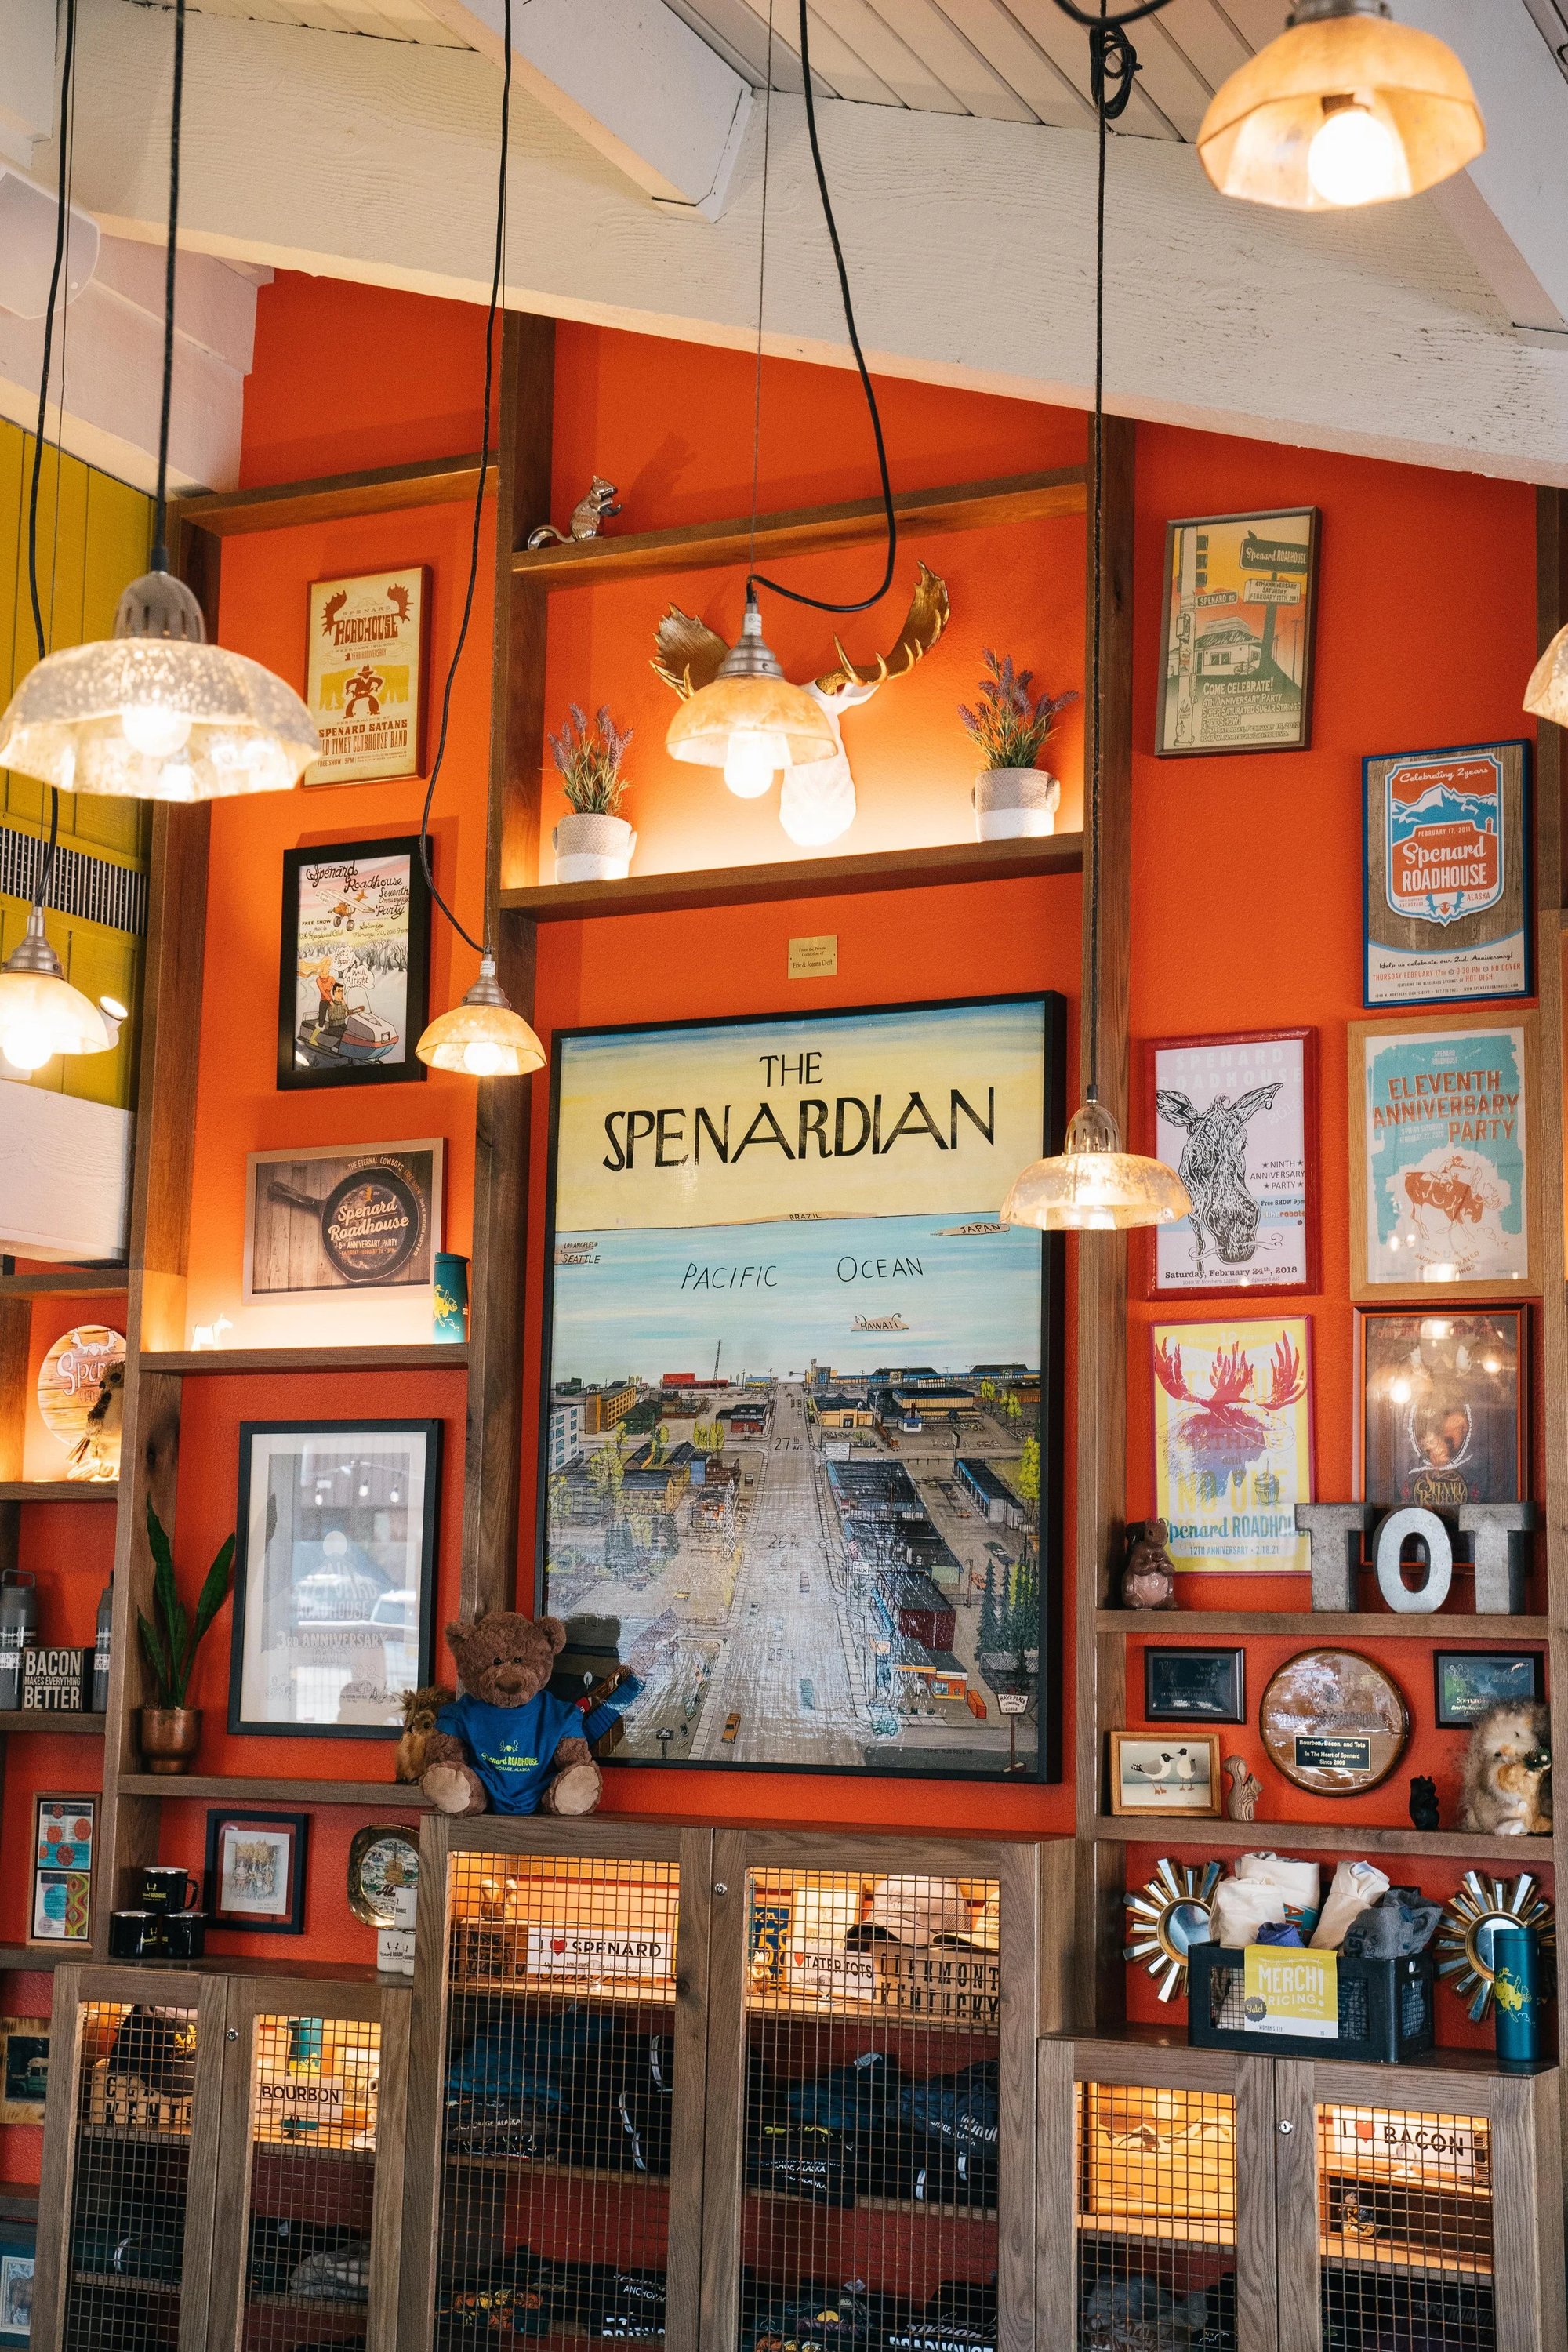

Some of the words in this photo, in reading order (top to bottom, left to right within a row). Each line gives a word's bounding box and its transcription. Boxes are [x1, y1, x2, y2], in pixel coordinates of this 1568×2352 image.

[1246, 547, 1276, 561] Spenard
[1277, 550, 1307, 564] ROADHOUSE
[1200, 594, 1228, 606] SPENARD
[343, 605, 391, 616] SPENARD
[333, 613, 398, 646] ROADHOUSE
[318, 724, 366, 738] SPENARD
[368, 719, 408, 732] SATANS
[331, 735, 352, 755] TIMEY
[353, 731, 389, 753] CLUBHOUSE
[390, 729, 408, 749] BAND
[317, 758, 328, 768] FREE
[328, 757, 342, 767] SHOW
[1399, 771, 1455, 782] Celebrating
[1417, 829, 1446, 838] FEBRUARY
[1402, 835, 1487, 869] Spenard
[306, 859, 358, 888] Spenard
[1402, 862, 1488, 892] ROADHOUSE
[343, 874, 403, 894] Roadhouse
[1467, 891, 1490, 902] ALASKA
[376, 904, 405, 920] Party
[1407, 959, 1439, 967] celebrate
[1470, 952, 1514, 962] Anniversary!
[1373, 971, 1403, 982] THURSDAY
[1403, 970, 1433, 979] FEBRUARY
[1501, 963, 1521, 971] COVER
[1465, 974, 1478, 982] HOT
[1176, 1048, 1284, 1069] SPENARD
[759, 1051, 823, 1088] THE
[1158, 1066, 1302, 1089] ROADHOUSE
[1388, 1069, 1501, 1101] ELEVENTH
[1373, 1093, 1520, 1130] ANNIVERSARY
[602, 1086, 995, 1172] SPENARDIAN
[1448, 1118, 1515, 1143] PARTY
[347, 1162, 358, 1171] THE
[358, 1156, 379, 1167] ETERNAL
[379, 1156, 405, 1171] COWBOYS
[1250, 1170, 1305, 1180] ANNIVERSARY
[1271, 1181, 1296, 1189] PARTY
[337, 1194, 397, 1227] Spenard
[789, 1212, 822, 1221] BRAZIL
[328, 1216, 410, 1242] Roadhouse
[960, 1223, 1002, 1235] JAPAN
[347, 1239, 382, 1249] ANNIVERSARY
[382, 1238, 398, 1247] PARTY
[561, 1254, 601, 1264] SEATTLE
[681, 1261, 779, 1290] PACIFIC
[837, 1256, 925, 1283] OCEAN
[1208, 1269, 1250, 1277] February
[859, 1319, 899, 1332] HAWAII
[1190, 1545, 1205, 1555] 12TH
[1207, 1544, 1248, 1555] ANNIVERSARY
[1256, 1544, 1279, 1555] 2.18.21
[1294, 1502, 1535, 1615] TOT
[302, 1632, 389, 1648] ANNIVERSARY
[25, 1650, 82, 1677] BACON
[313, 1648, 353, 1664] PARTY
[24, 1676, 45, 1686] MAKES
[45, 1676, 82, 1686] EVERYTHING
[24, 1686, 80, 1709] BETTER
[507, 1755, 539, 1766] ROADHOUSE
[572, 1940, 662, 1958] SPENARD
[805, 1955, 842, 1974] TATER
[843, 1961, 873, 1980] TOTS
[1258, 1964, 1324, 2007] MERCH!
[1245, 2003, 1264, 2014] Sale!
[262, 2085, 339, 2104] BOURBON
[1383, 2125, 1465, 2157] BACON
